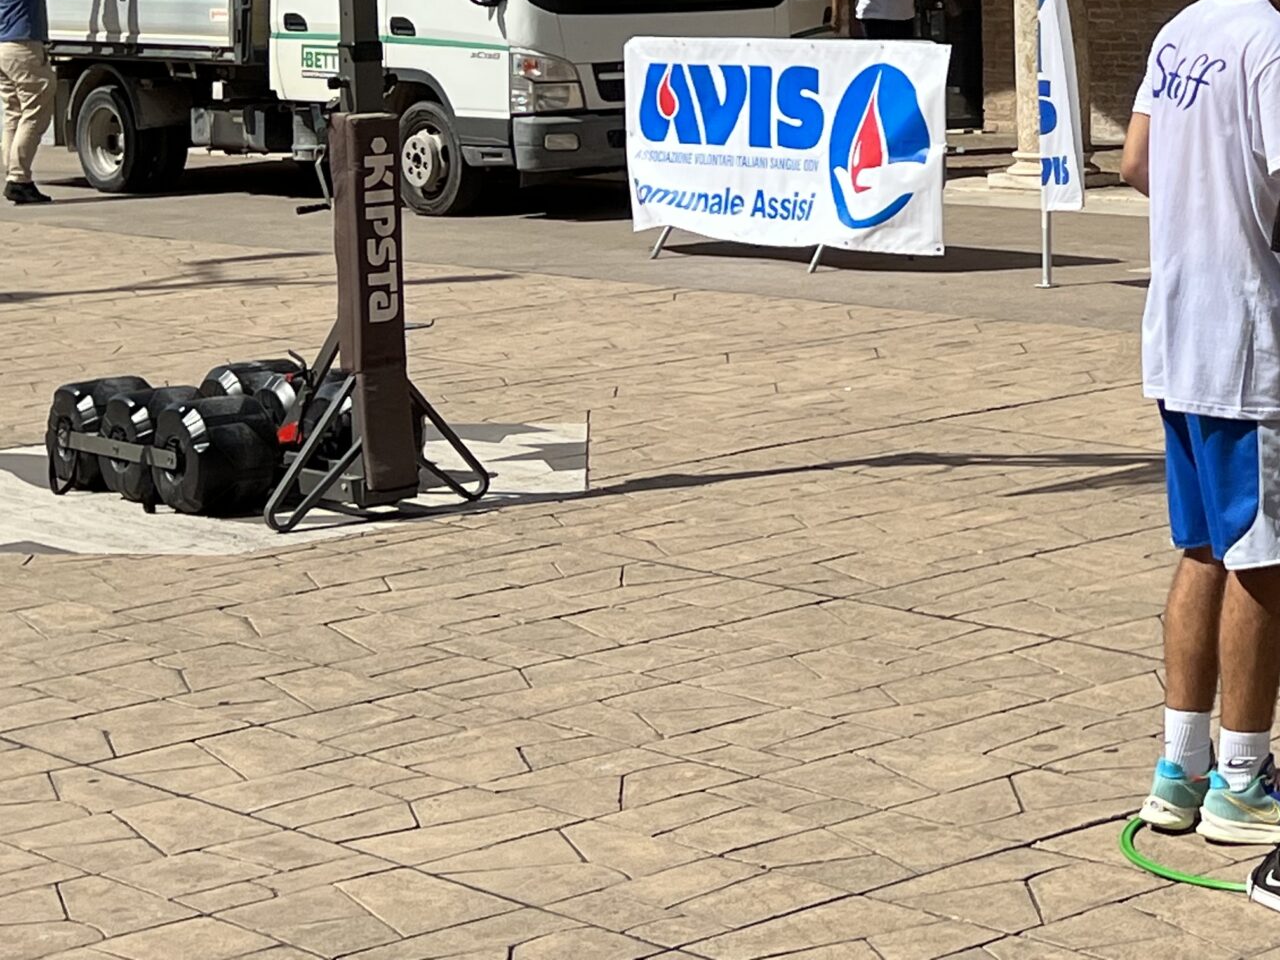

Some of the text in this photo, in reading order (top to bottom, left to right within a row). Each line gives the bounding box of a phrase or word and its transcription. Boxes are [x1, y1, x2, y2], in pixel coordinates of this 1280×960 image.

[305, 51, 339, 69] BETT
[639, 63, 825, 150] AVIS
[769, 157, 801, 172] SANGUE
[750, 189, 816, 221] Assisi
